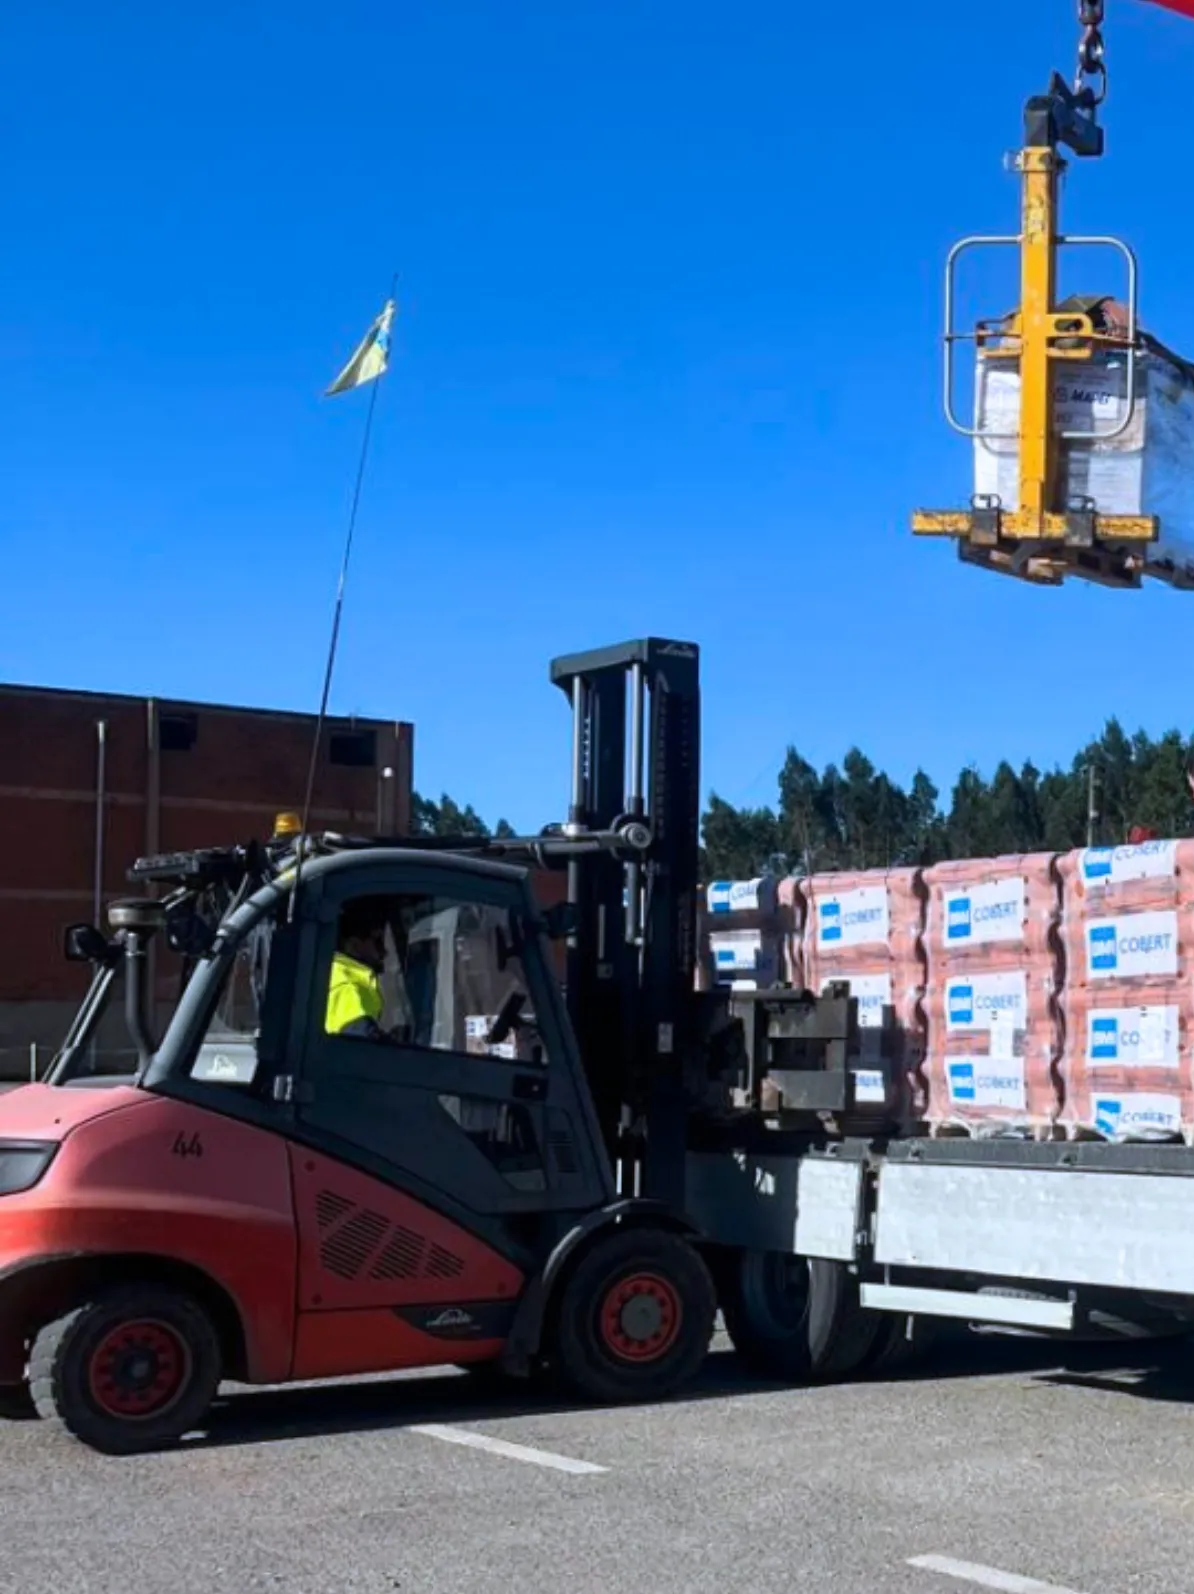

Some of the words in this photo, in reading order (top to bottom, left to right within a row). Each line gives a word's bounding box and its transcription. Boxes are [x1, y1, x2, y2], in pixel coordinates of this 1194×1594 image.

[843, 906, 884, 925] COBERT
[973, 900, 1018, 922] COBERT
[1119, 933, 1172, 954] COBERT
[975, 994, 1021, 1010] COBERT
[977, 1076, 1020, 1091] COBERT
[172, 1130, 203, 1158] 44
